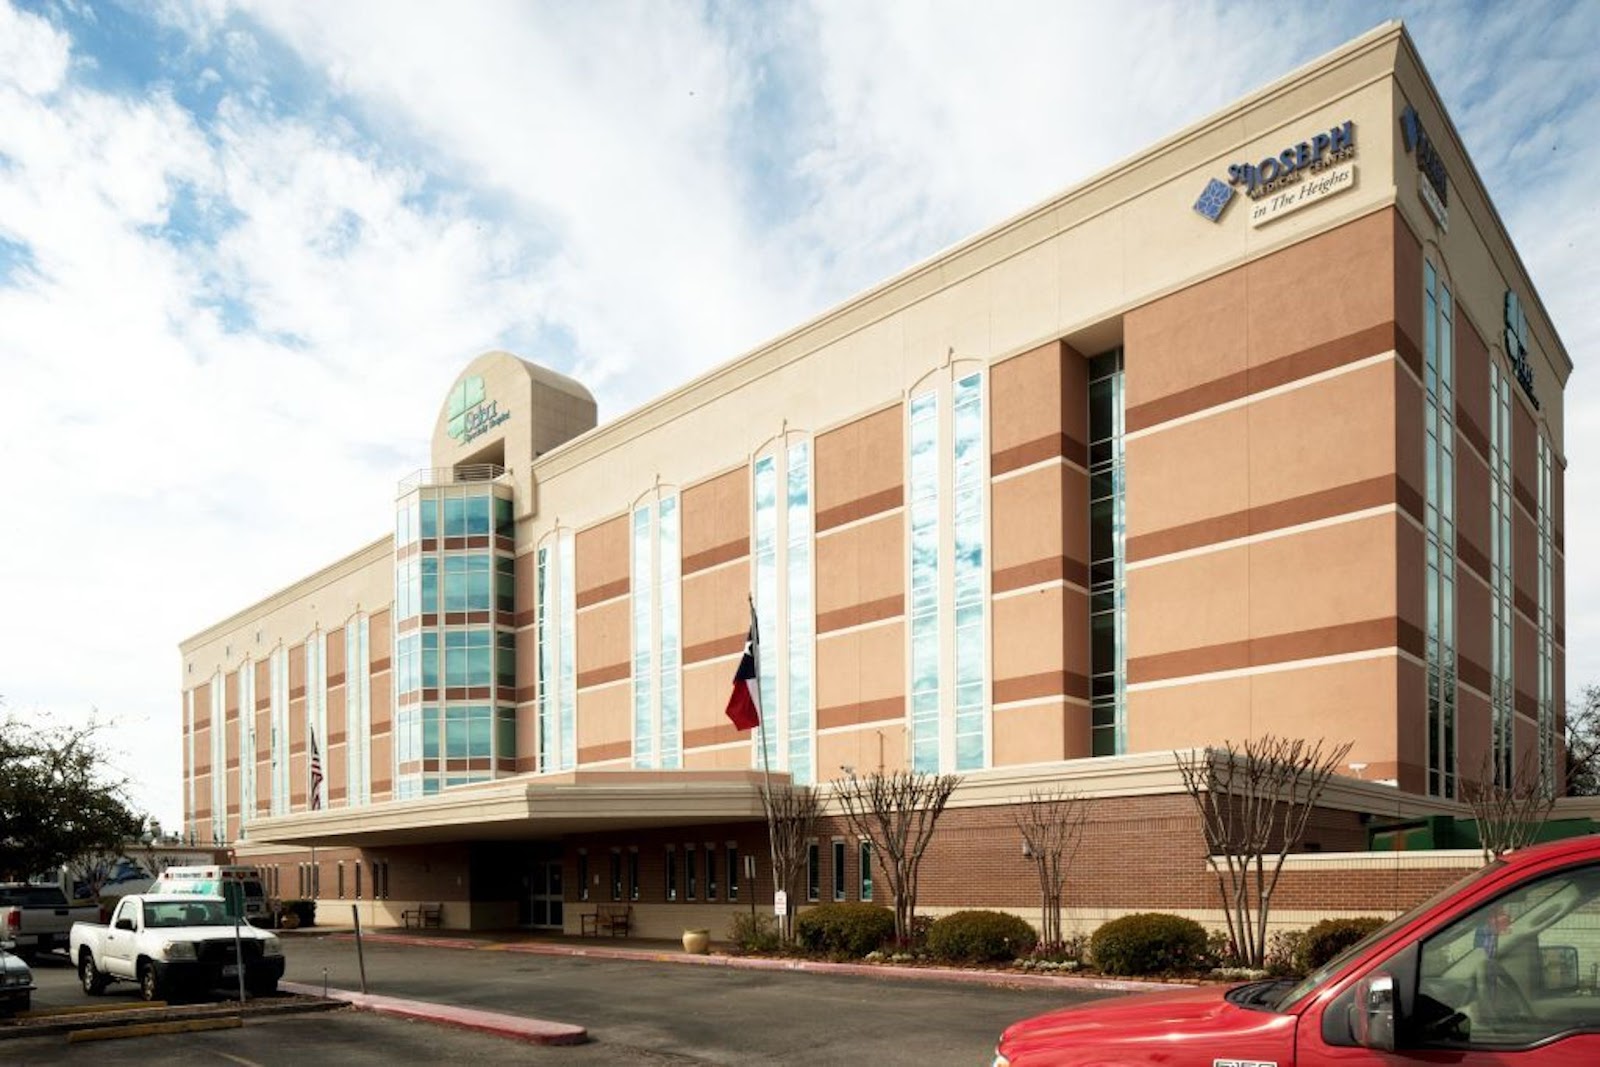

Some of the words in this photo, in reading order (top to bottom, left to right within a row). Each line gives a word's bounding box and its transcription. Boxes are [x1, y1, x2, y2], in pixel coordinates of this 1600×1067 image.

[1246, 120, 1353, 196] JOSEPH
[1251, 171, 1302, 200] MEDICAL
[1310, 147, 1354, 174] CENTER
[1253, 206, 1267, 219] in
[1272, 192, 1294, 212] The
[1300, 170, 1350, 200] Heights
